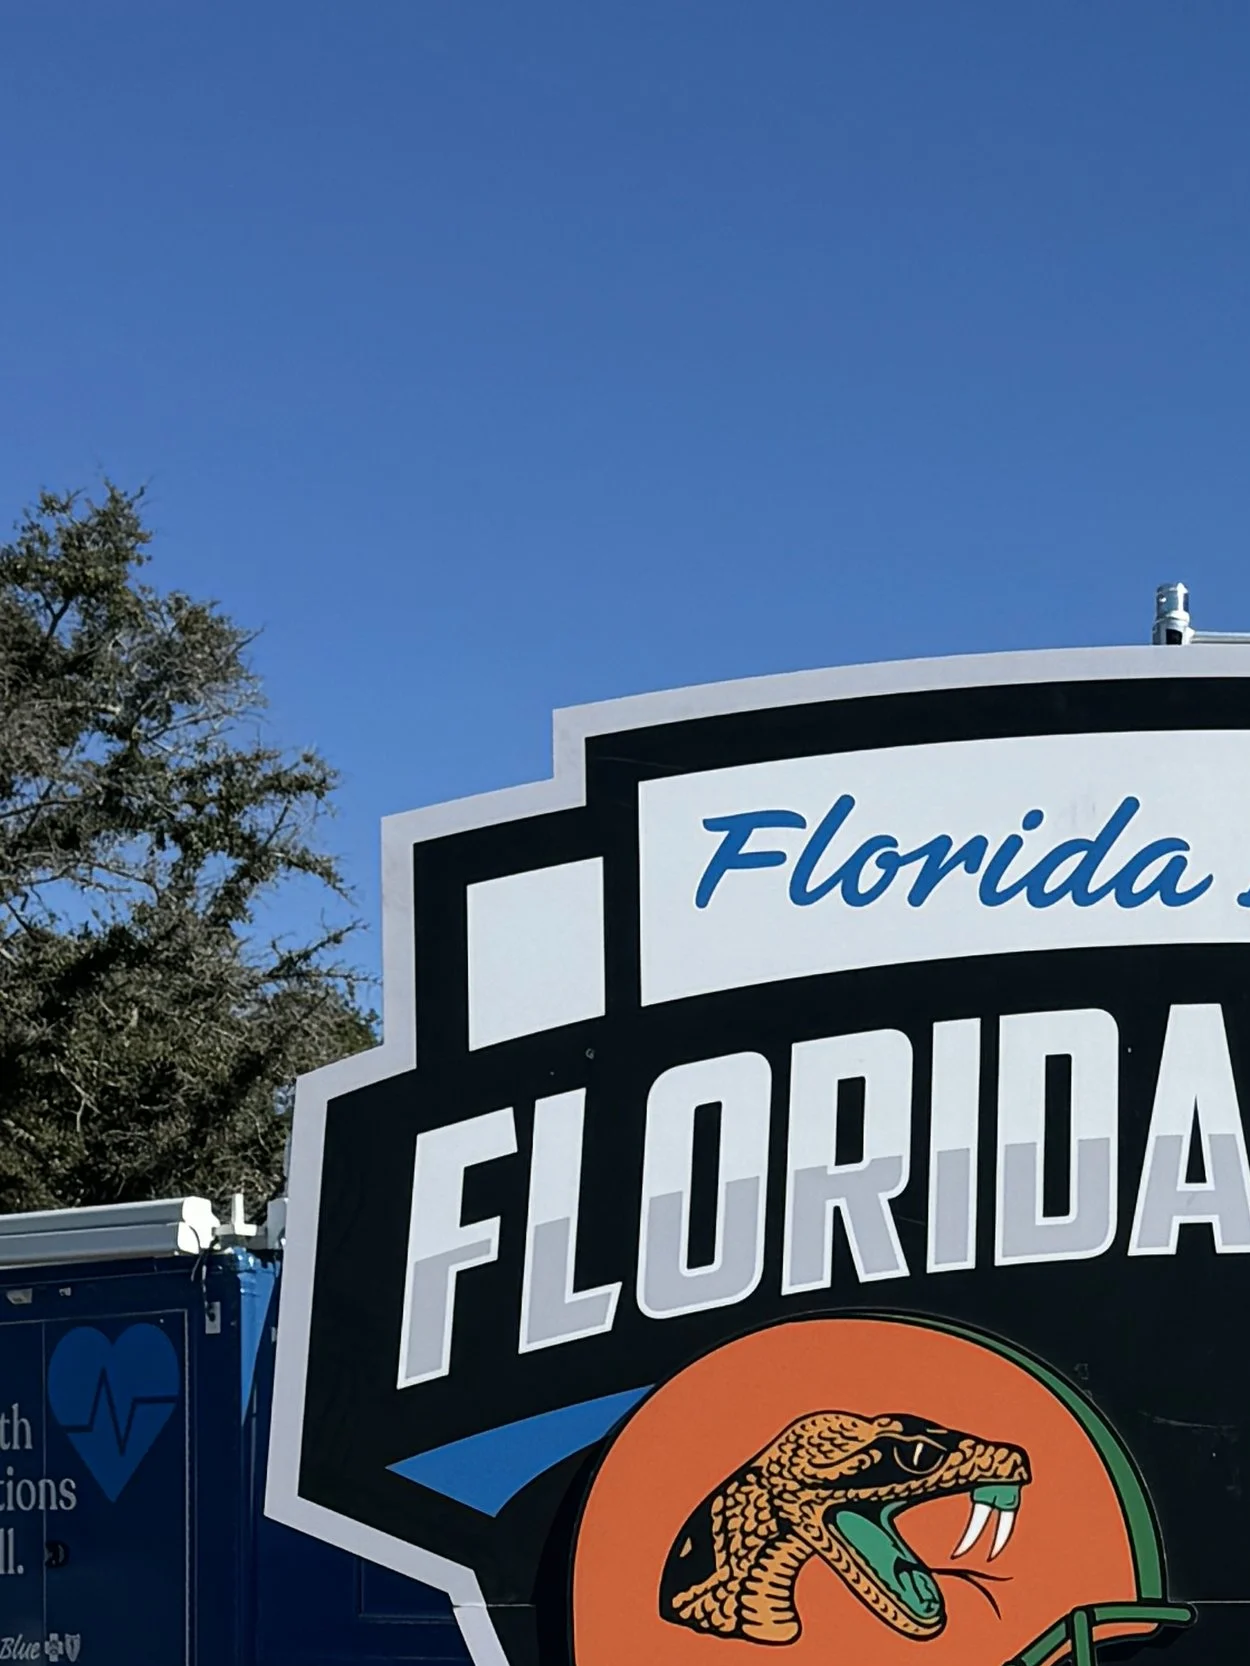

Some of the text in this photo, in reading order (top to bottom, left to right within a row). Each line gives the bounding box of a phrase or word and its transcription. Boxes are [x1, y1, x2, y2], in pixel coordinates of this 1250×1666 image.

[695, 794, 1214, 909] Florida
[0, 1466, 77, 1511] ions
[0, 1634, 41, 1660] Blue
